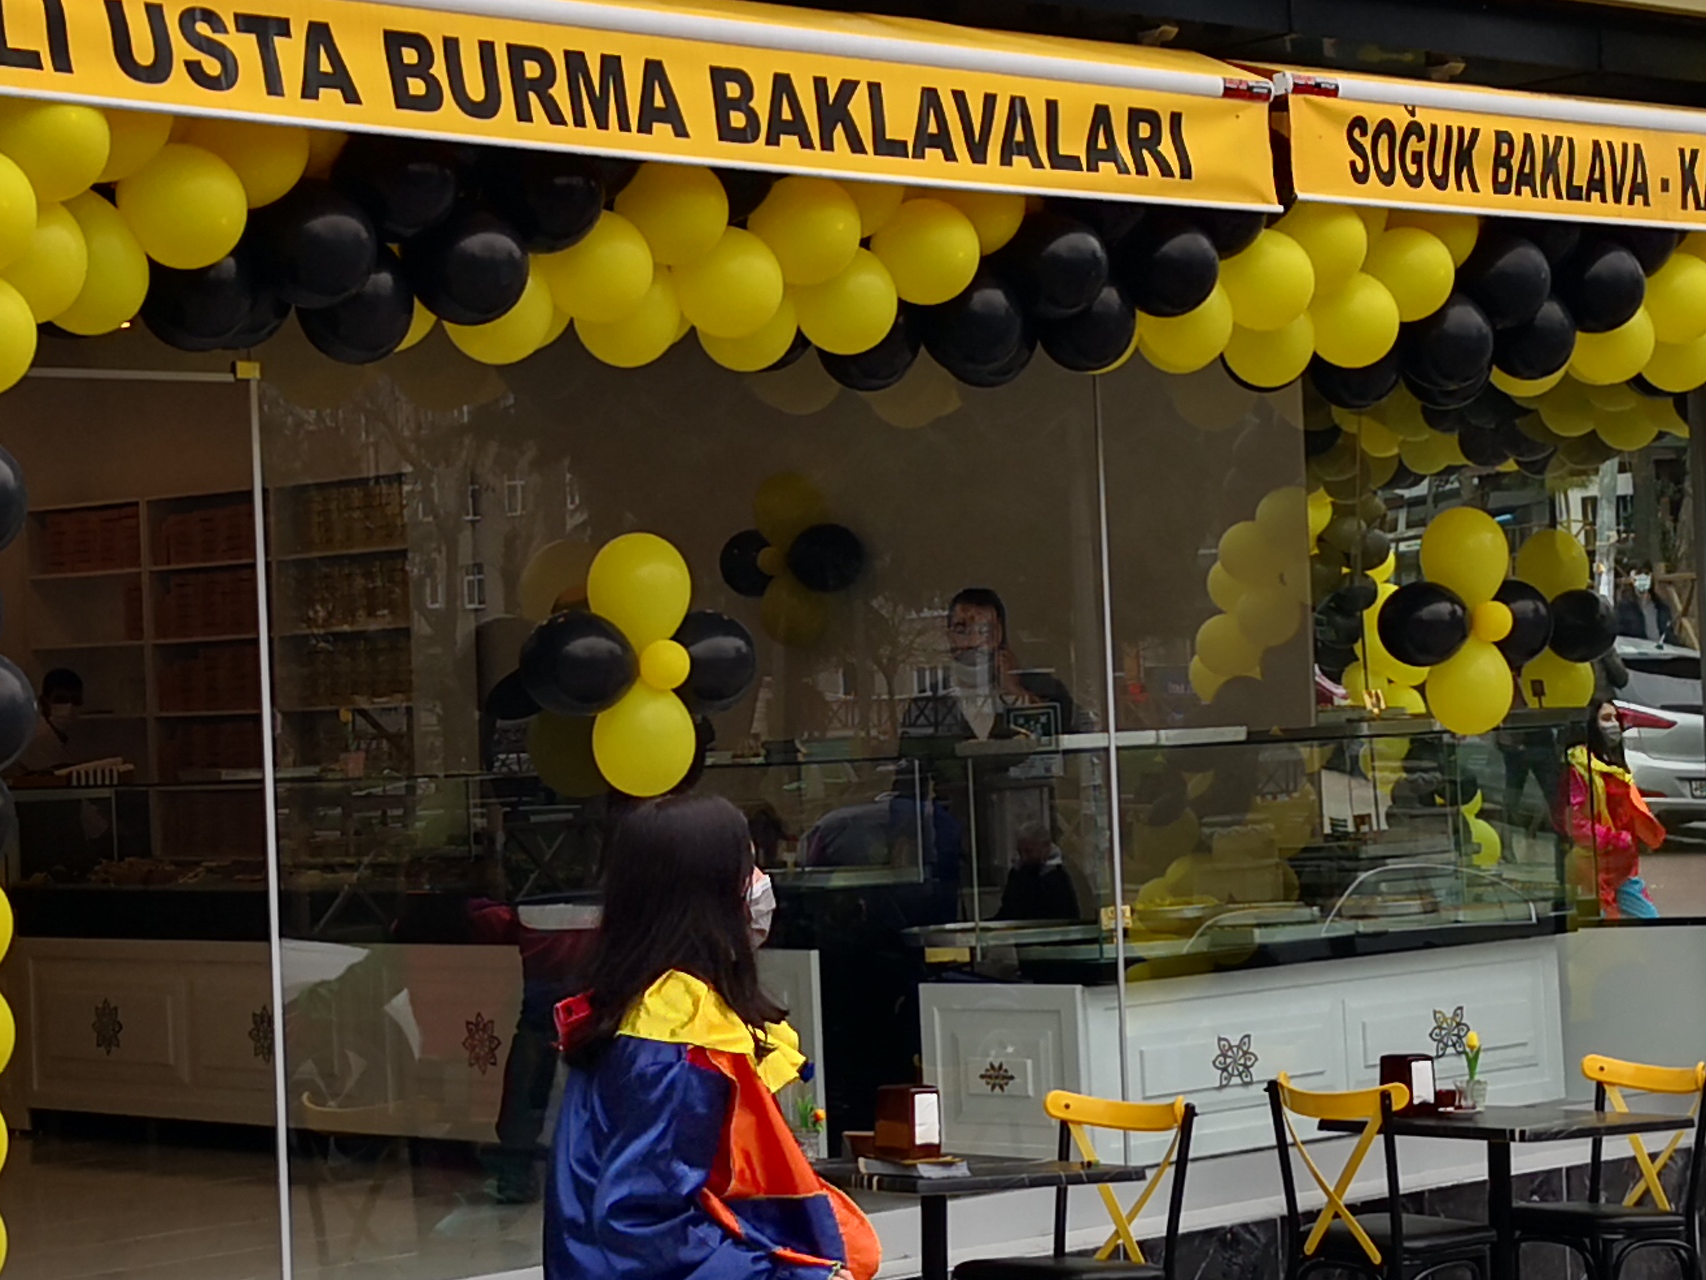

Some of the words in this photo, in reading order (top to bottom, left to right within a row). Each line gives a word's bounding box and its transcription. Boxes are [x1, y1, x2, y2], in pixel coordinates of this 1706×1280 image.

[382, 27, 691, 140] BURMA
[709, 64, 1195, 181] BAKLAVALARI
[1345, 104, 1481, 194] SOĞUK
[1492, 133, 1652, 208] BAKLAVA
